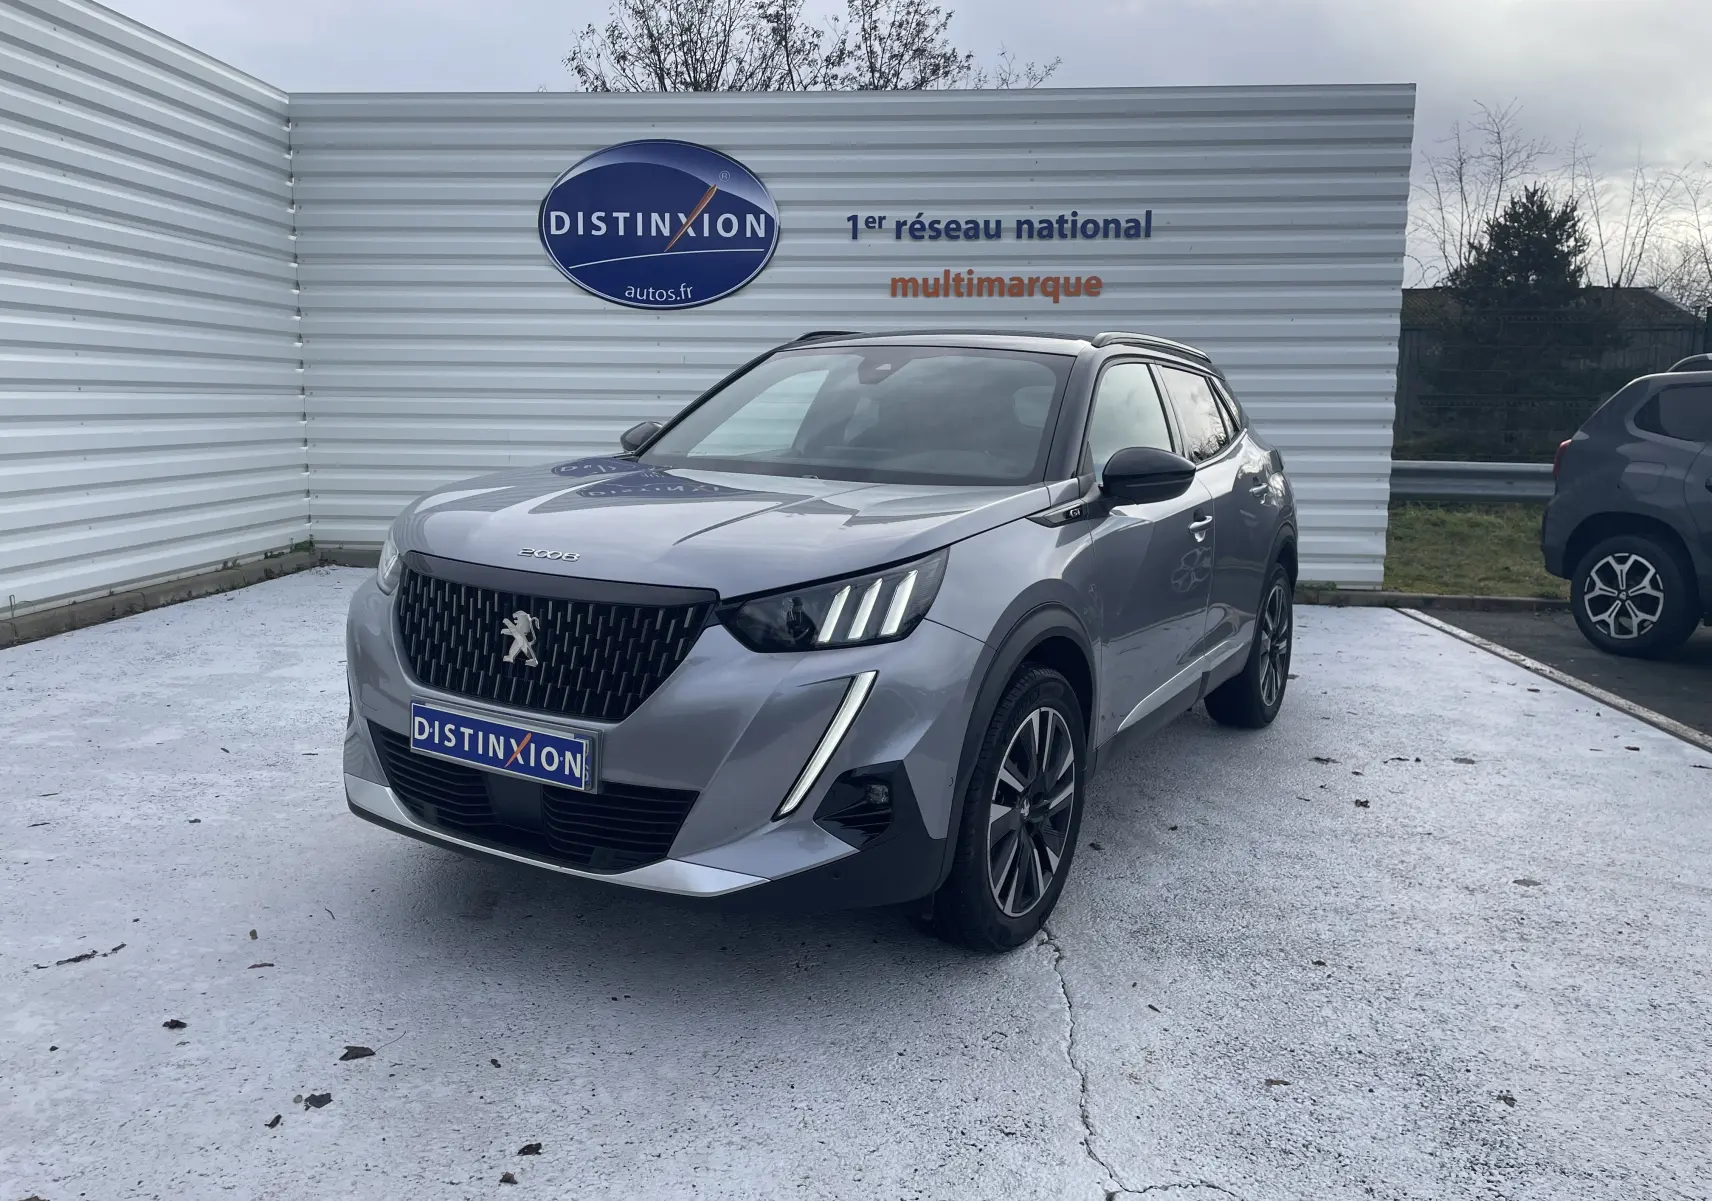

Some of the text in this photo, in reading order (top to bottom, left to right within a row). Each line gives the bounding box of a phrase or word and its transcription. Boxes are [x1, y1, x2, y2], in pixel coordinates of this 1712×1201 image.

[549, 211, 766, 238] DISTINXION
[846, 210, 1152, 240] 1er réseau national
[624, 282, 693, 301] autos.fr
[890, 269, 1103, 304] multimarque
[517, 547, 580, 562] 2008
[413, 716, 582, 778] DISTINXION
